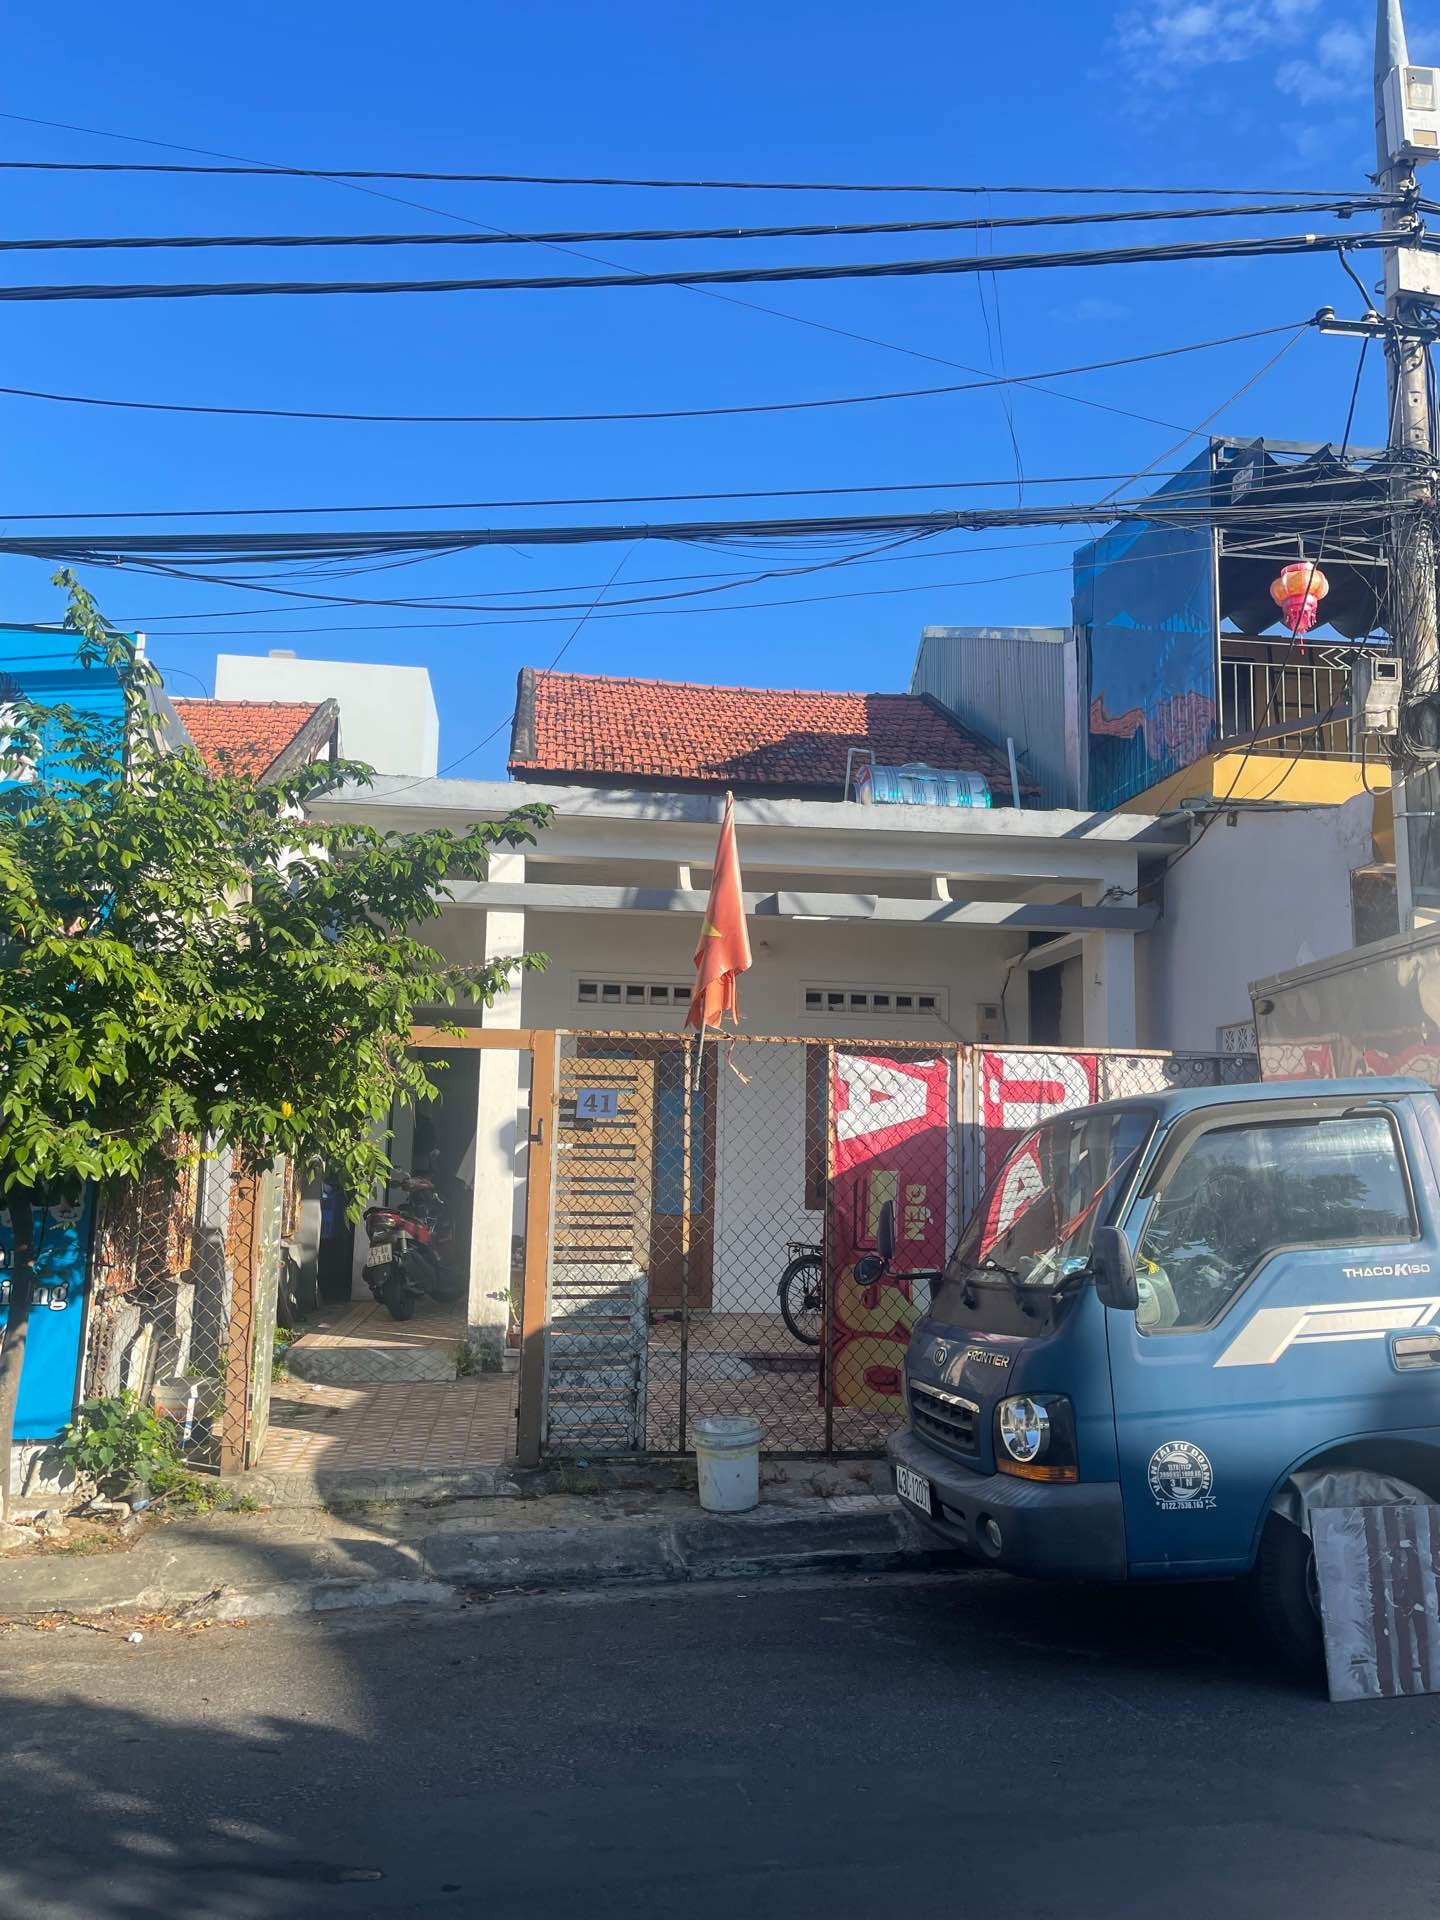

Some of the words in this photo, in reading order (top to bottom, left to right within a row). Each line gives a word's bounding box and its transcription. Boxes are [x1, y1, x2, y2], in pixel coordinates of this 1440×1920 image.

[583, 1093, 611, 1113] 41
[1342, 1266, 1393, 1278] THACO
[967, 1350, 1010, 1368] FRONTIER
